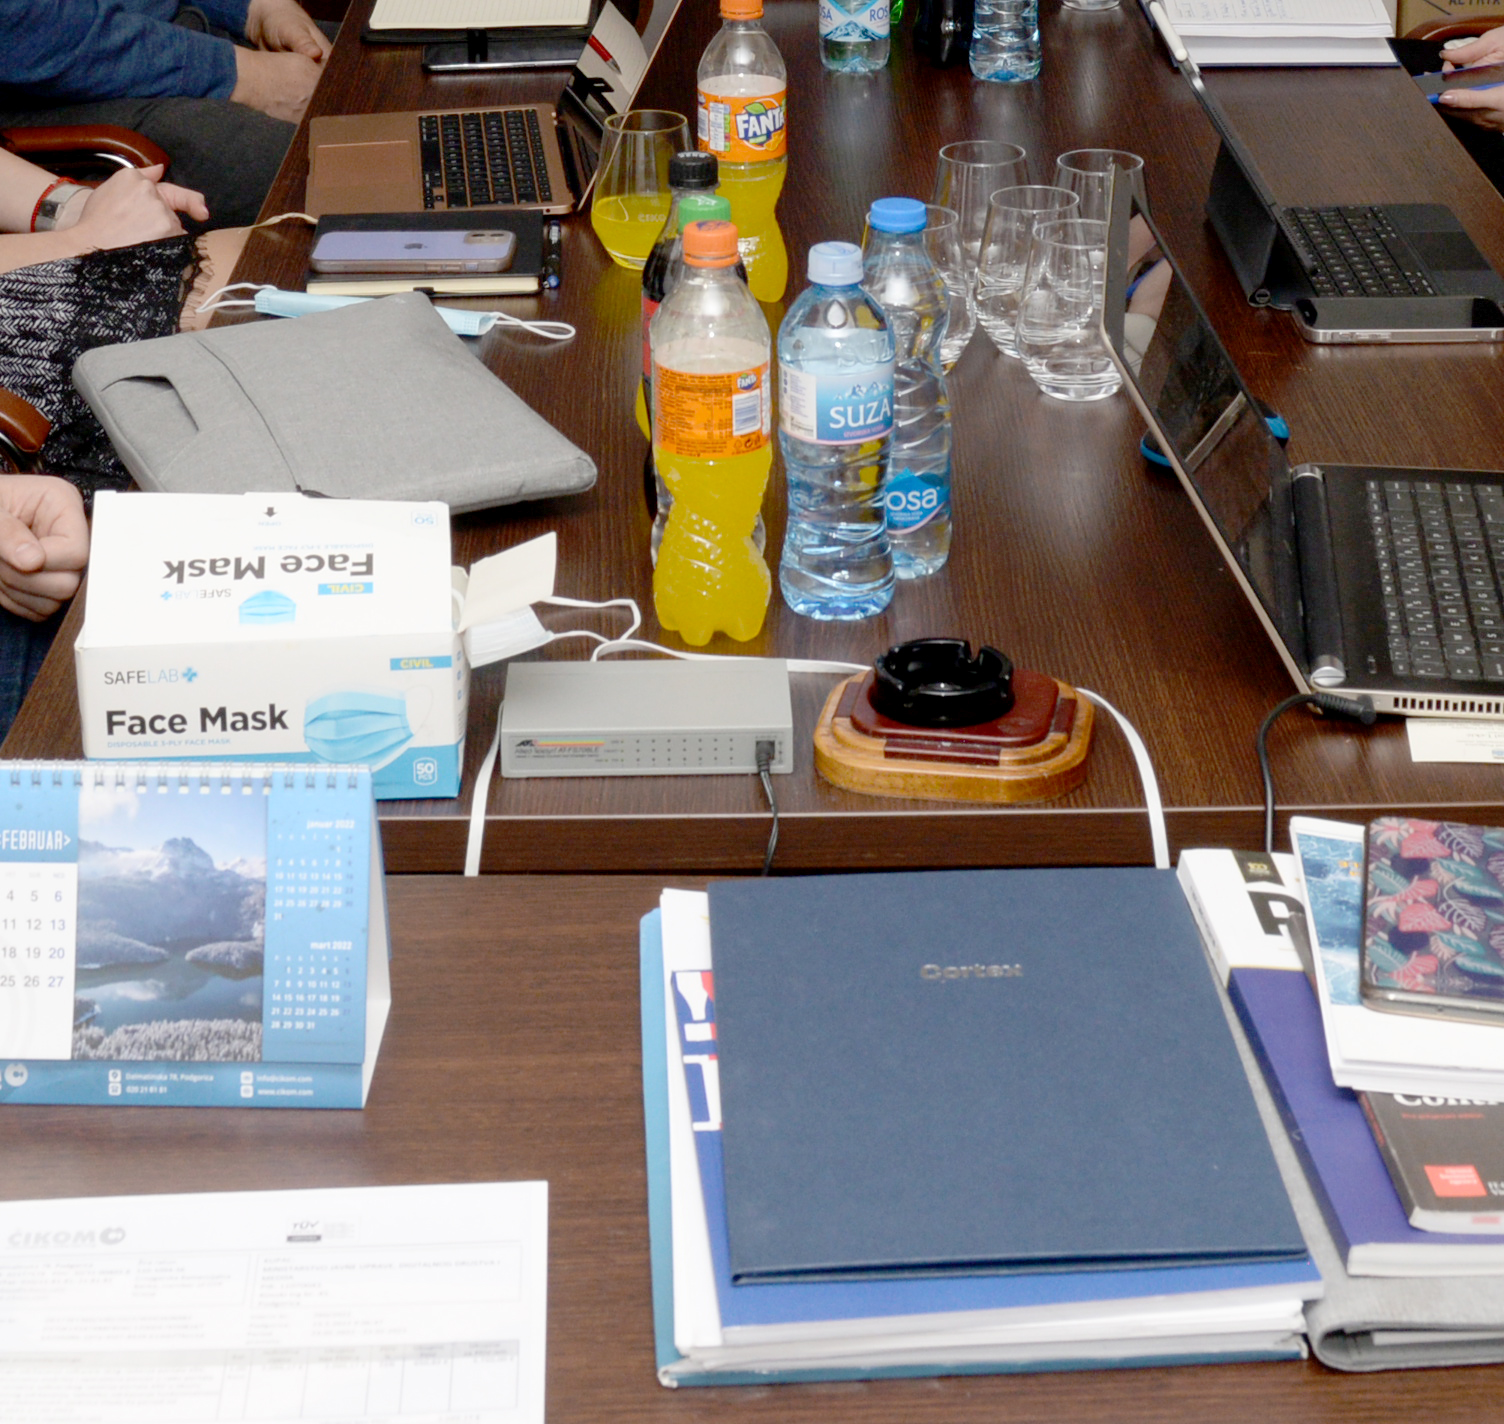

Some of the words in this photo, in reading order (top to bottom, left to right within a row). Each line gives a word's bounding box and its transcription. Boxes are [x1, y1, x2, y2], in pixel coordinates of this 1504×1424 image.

[735, 106, 785, 139] FANTA
[829, 397, 892, 429] SUZA
[885, 487, 938, 511] osa
[162, 555, 266, 585] Mask
[280, 553, 374, 577] Face
[327, 582, 365, 594] CIVIL
[399, 657, 433, 669] CIVIL
[104, 668, 179, 685] SAFELAB
[106, 709, 188, 736] Face
[199, 703, 290, 733] Mask
[107, 740, 158, 748] DISPOSABLE
[184, 738, 206, 746] FACE
[208, 737, 231, 745] MASK
[416, 762, 434, 775] 50
[7, 891, 14, 901] 4
[31, 891, 38, 902] 5
[55, 891, 62, 902] 6
[3, 919, 16, 930] 11
[27, 919, 41, 930] 12
[51, 919, 65, 931] 13
[2, 947, 16, 958] 18
[26, 948, 40, 958] 19
[49, 948, 64, 959] 20
[0, 976, 15, 987] 25
[24, 976, 39, 987] 26
[48, 976, 64, 987] 27
